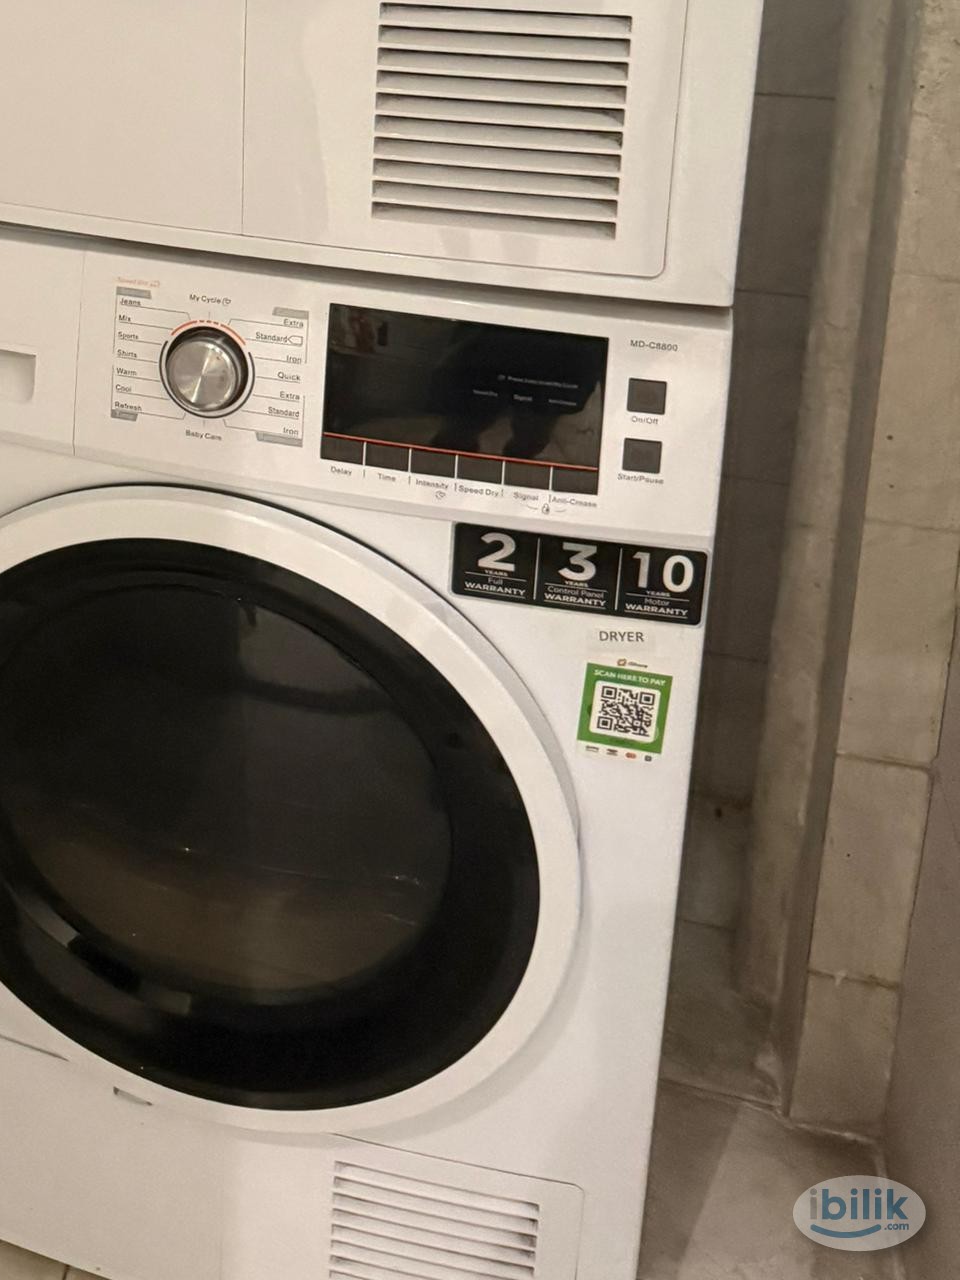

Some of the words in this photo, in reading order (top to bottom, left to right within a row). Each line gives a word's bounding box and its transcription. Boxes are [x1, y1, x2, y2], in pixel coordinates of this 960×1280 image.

[189, 294, 199, 302] My
[201, 295, 221, 305] Cycle
[283, 318, 304, 328] Extra
[118, 331, 139, 340] Sports
[255, 331, 288, 343] Standard
[117, 349, 137, 358] Shirts
[286, 355, 302, 364] Iron
[116, 367, 137, 376] Warm
[277, 371, 301, 381] Quick
[279, 391, 300, 400] Extra
[268, 406, 300, 418] Standard
[283, 427, 299, 435] Iron
[330, 466, 352, 476] Delay
[377, 472, 396, 482] Time
[459, 485, 484, 496] Speed
[485, 487, 499, 498] Dry
[513, 492, 538, 502] Signal
[477, 532, 516, 572] 2
[558, 542, 597, 581] 3
[632, 551, 694, 593] 10
[487, 577, 503, 586] Full
[565, 580, 589, 588] YEARS
[464, 581, 526, 596] WARRANTY
[547, 585, 579, 597] Control
[580, 589, 604, 599] Panel
[544, 592, 607, 607] WARRANTY
[644, 597, 670, 607] Motor
[625, 603, 688, 617] WARRANTY
[599, 630, 644, 643] DRYER
[594, 669, 616, 678] SCAN
